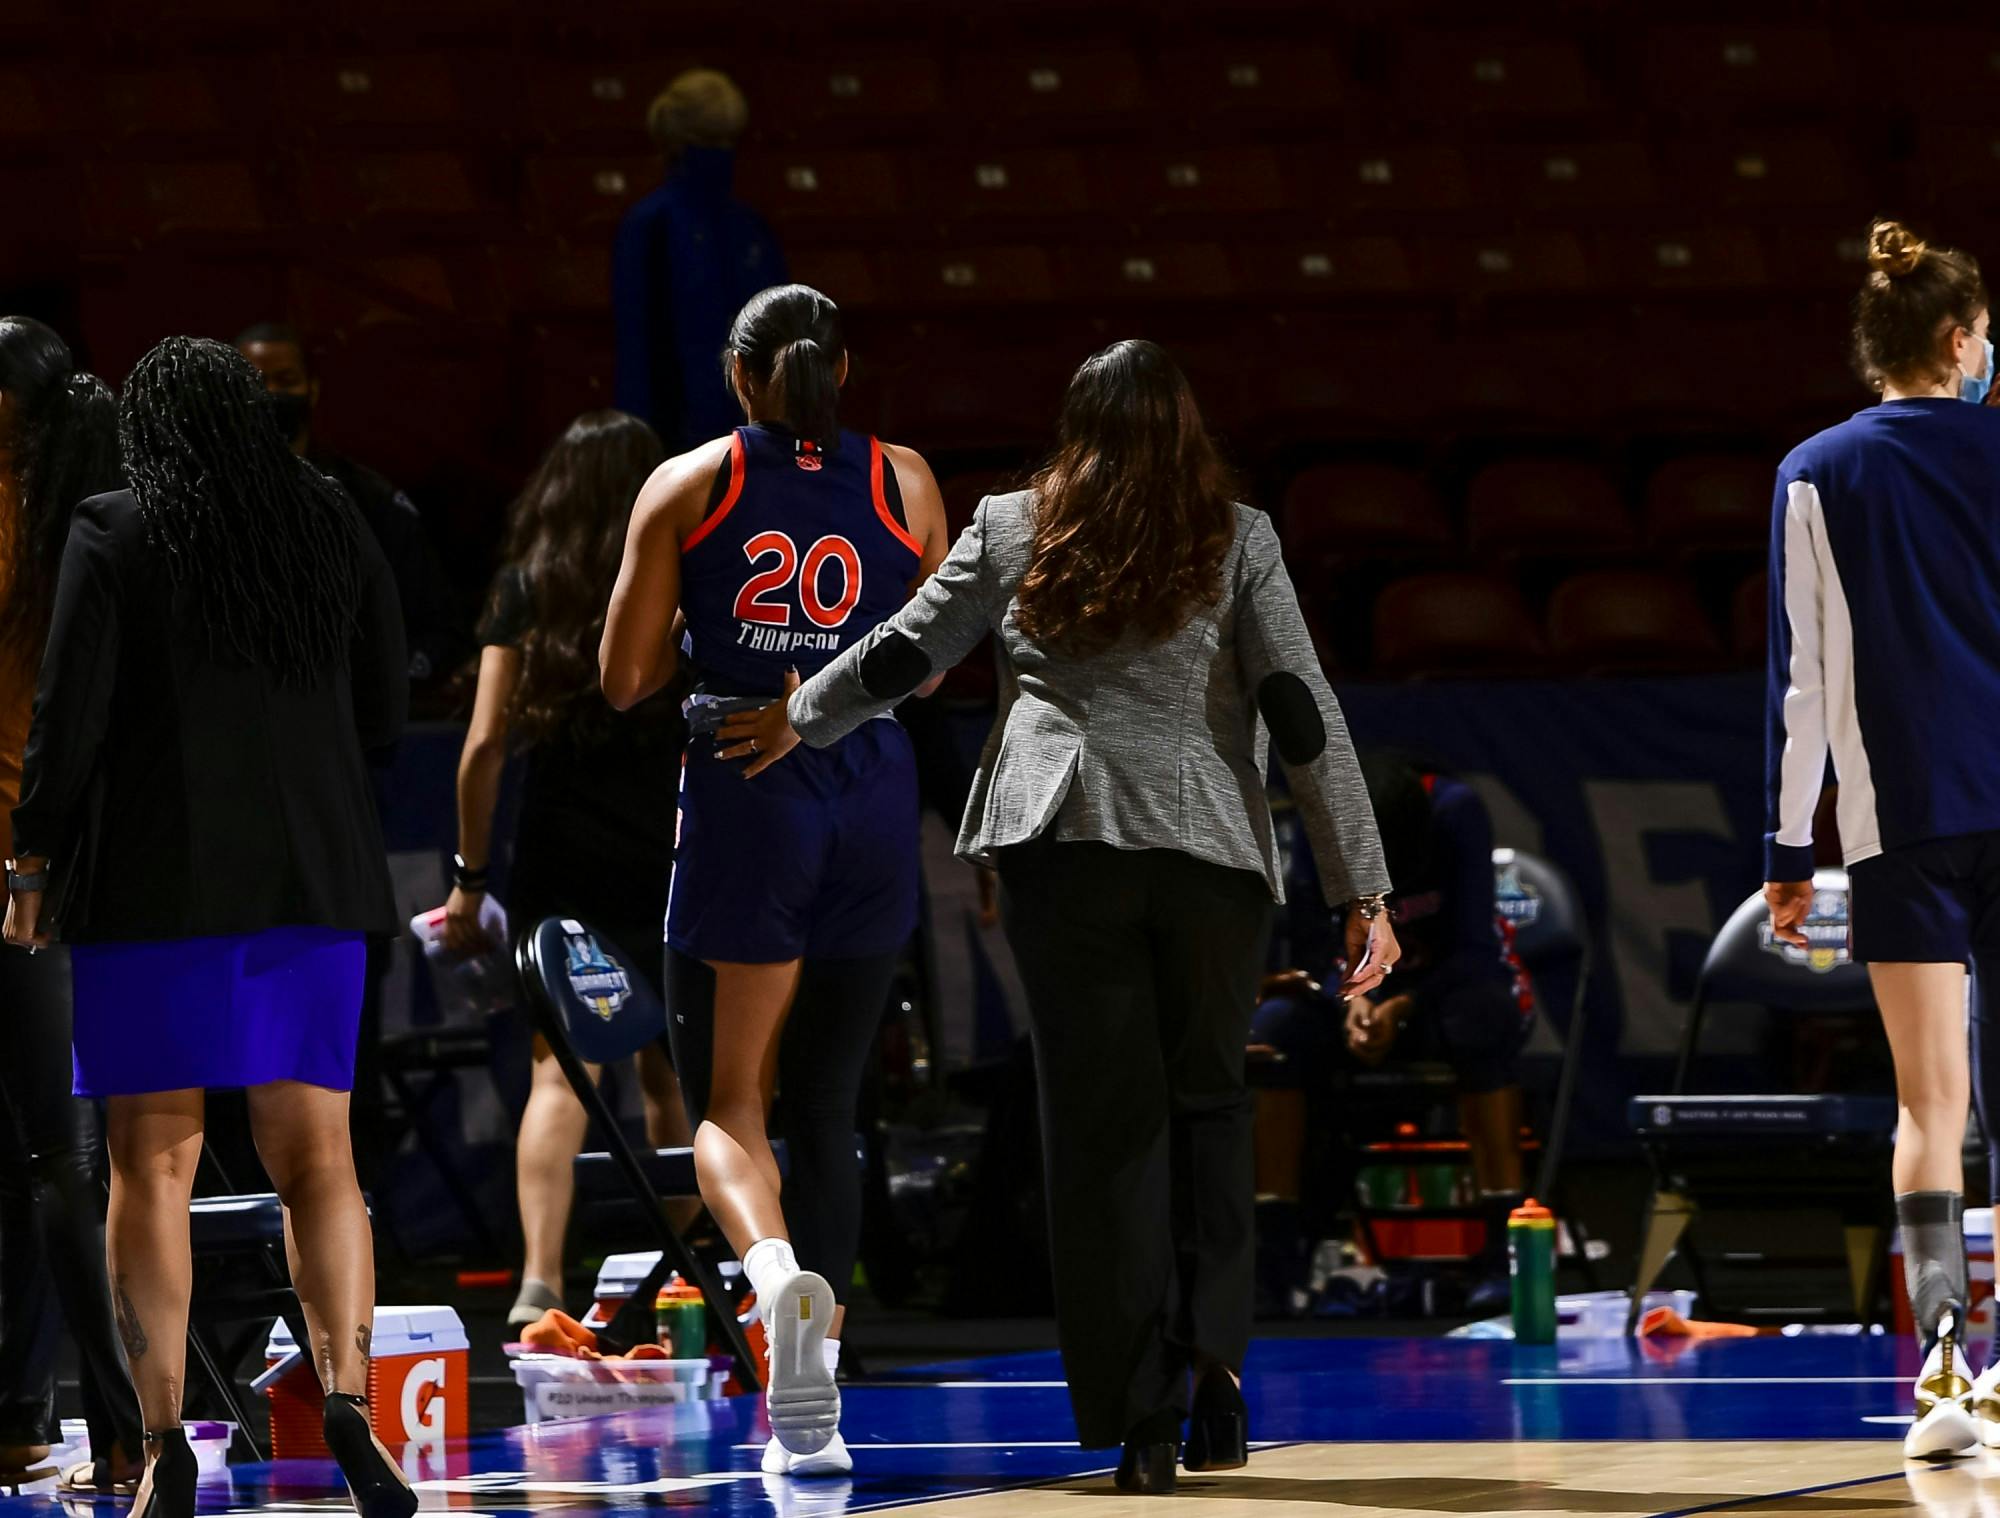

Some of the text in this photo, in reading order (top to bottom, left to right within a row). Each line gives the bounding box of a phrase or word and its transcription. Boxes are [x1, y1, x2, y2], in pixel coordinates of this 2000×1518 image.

[733, 530, 862, 628] 20
[737, 622, 840, 651] THOMPSON
[400, 1358, 446, 1442] G
